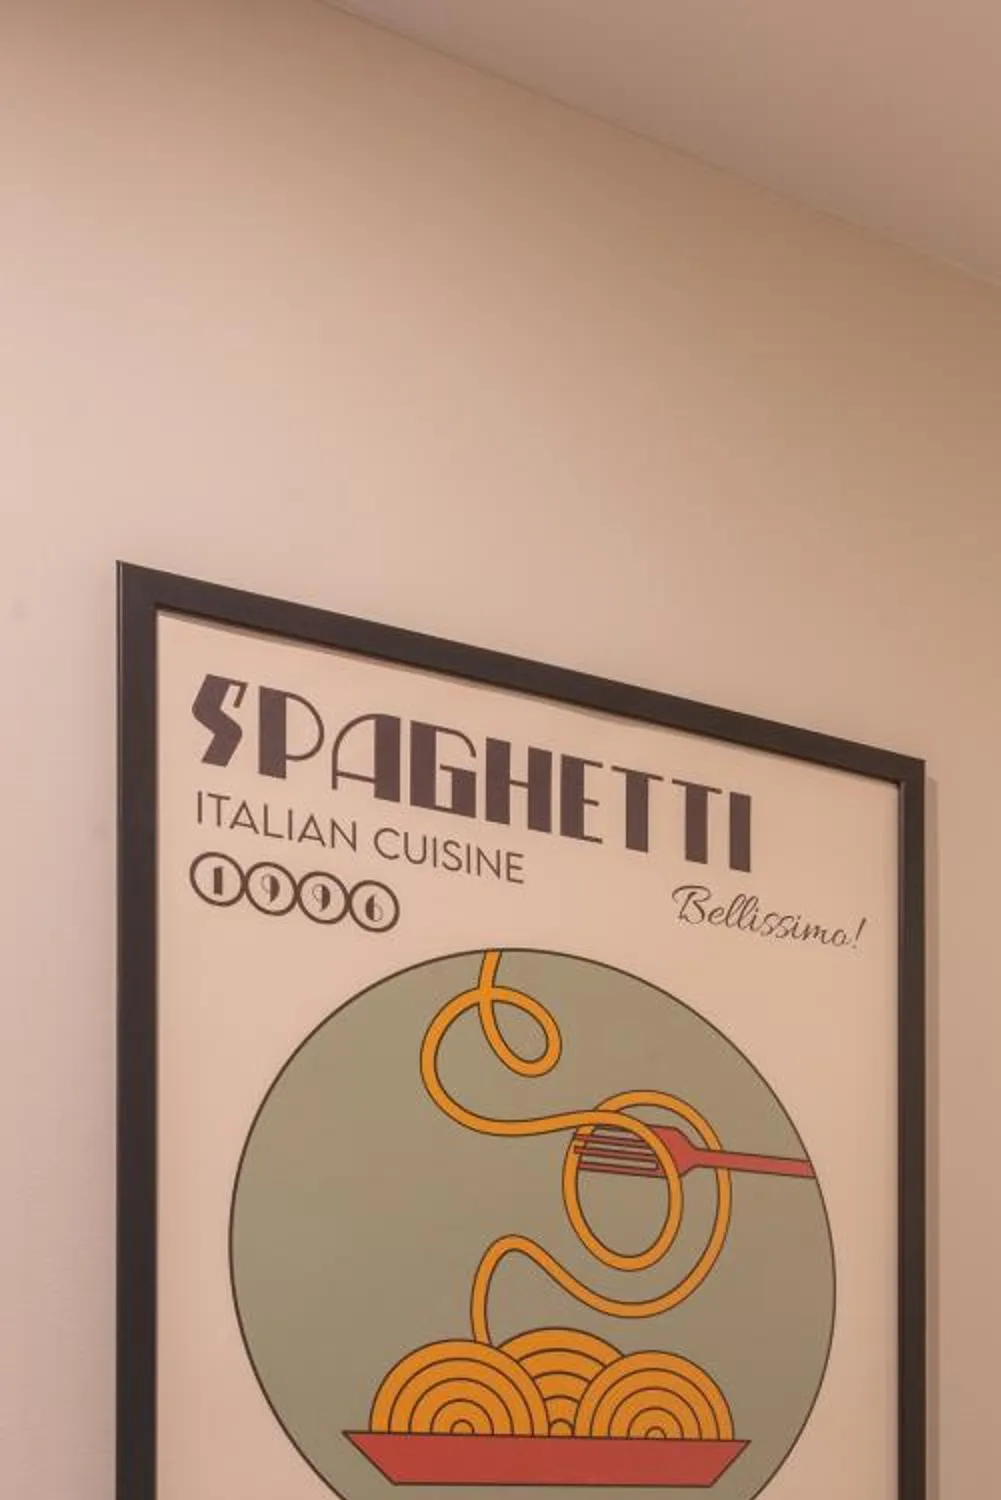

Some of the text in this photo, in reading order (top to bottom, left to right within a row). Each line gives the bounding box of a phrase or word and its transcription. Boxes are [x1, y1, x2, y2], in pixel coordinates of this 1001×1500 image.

[191, 672, 752, 874] SPAGHETTI
[196, 790, 526, 885] ITALIAN CUISINE
[671, 884, 867, 950] Bellissimo!
